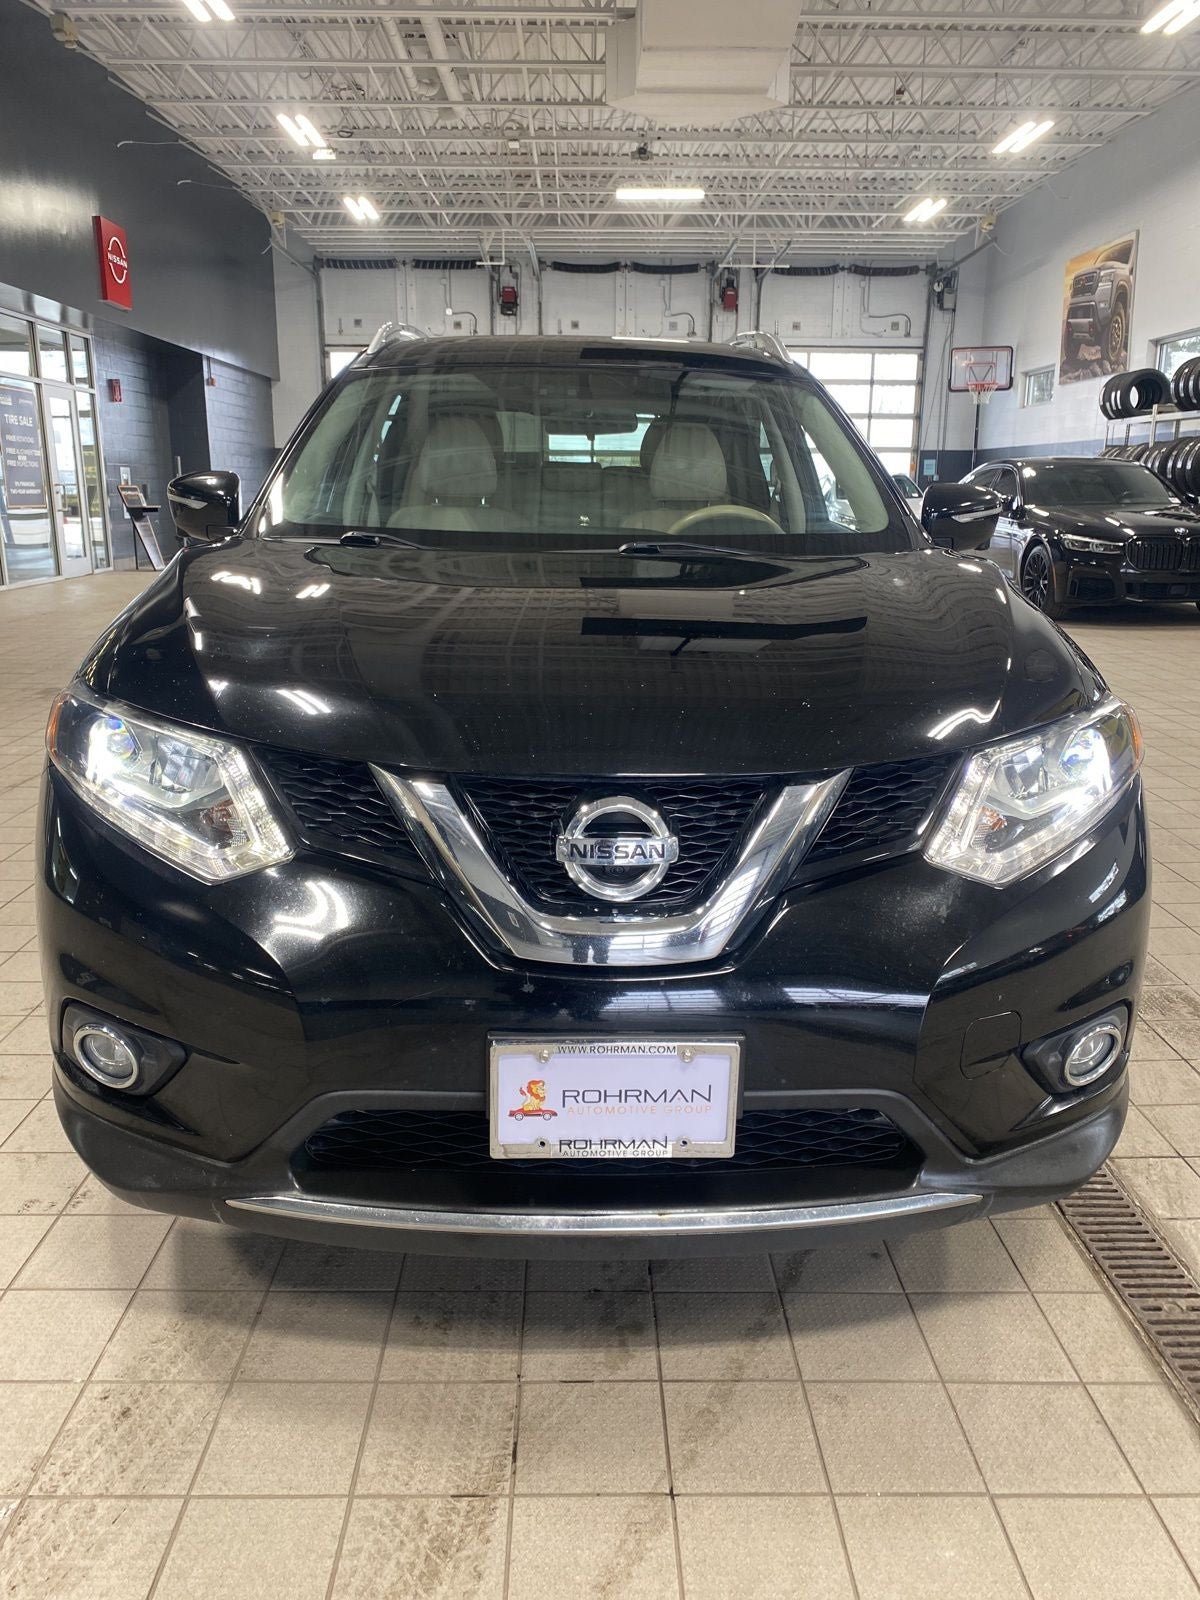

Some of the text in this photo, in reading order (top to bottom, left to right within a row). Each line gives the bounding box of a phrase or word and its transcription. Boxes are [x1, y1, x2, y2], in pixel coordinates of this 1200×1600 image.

[107, 252, 128, 269] NISSAN
[4, 414, 33, 427] TIRE SALE
[569, 843, 665, 860] NISSAN
[557, 1045, 677, 1055] WWW.ROHRMAN.COM
[562, 1084, 712, 1108] ROHRMAN
[567, 1105, 712, 1115] AUTOMOTIVE GROUP
[559, 1135, 668, 1153] ROHRMAN
[562, 1149, 668, 1158] AUTOMOTIVE GROUP
